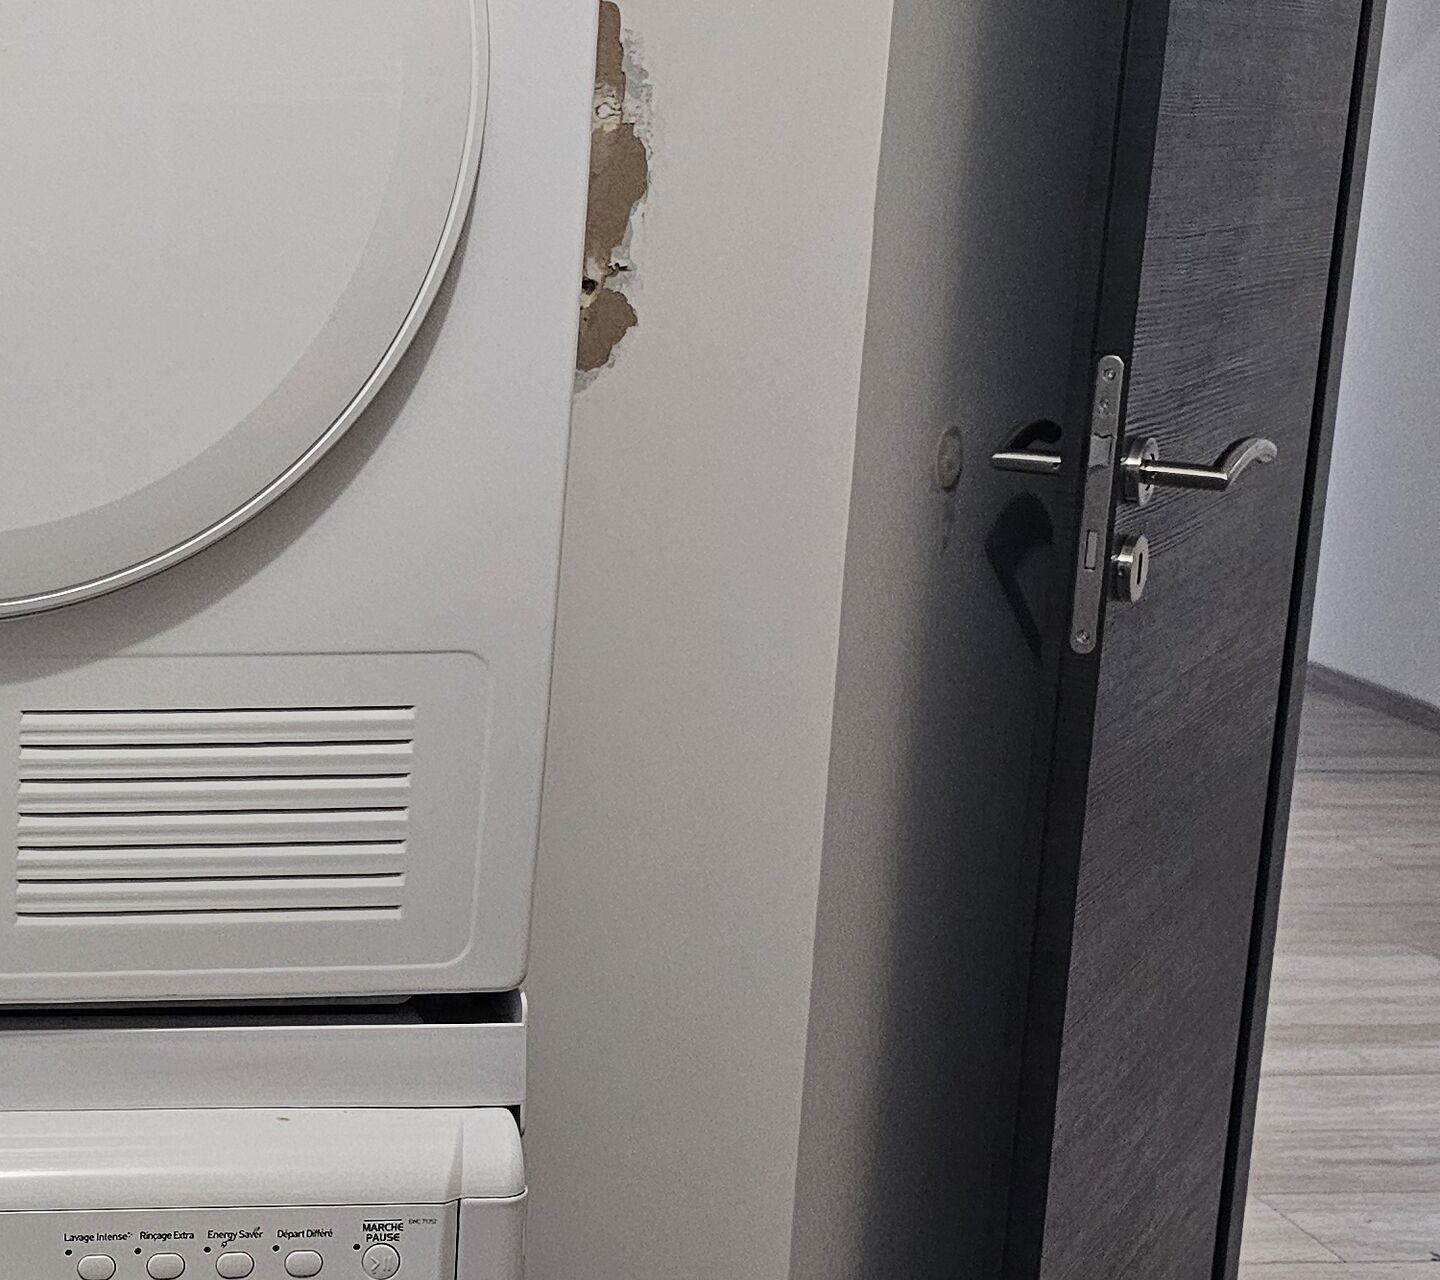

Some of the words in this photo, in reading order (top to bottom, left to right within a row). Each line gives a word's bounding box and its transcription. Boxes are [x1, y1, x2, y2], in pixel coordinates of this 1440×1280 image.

[362, 1223, 404, 1232] MARCHE
[64, 1232, 94, 1243] Lavage
[97, 1232, 127, 1241] Intense
[140, 1231, 172, 1242] Rinçage
[173, 1231, 194, 1239] Extra
[208, 1230, 237, 1241] Energy
[239, 1229, 263, 1239] Saver
[277, 1229, 304, 1240] Départ
[306, 1228, 333, 1238] Différé
[366, 1233, 400, 1242] PAUSE
